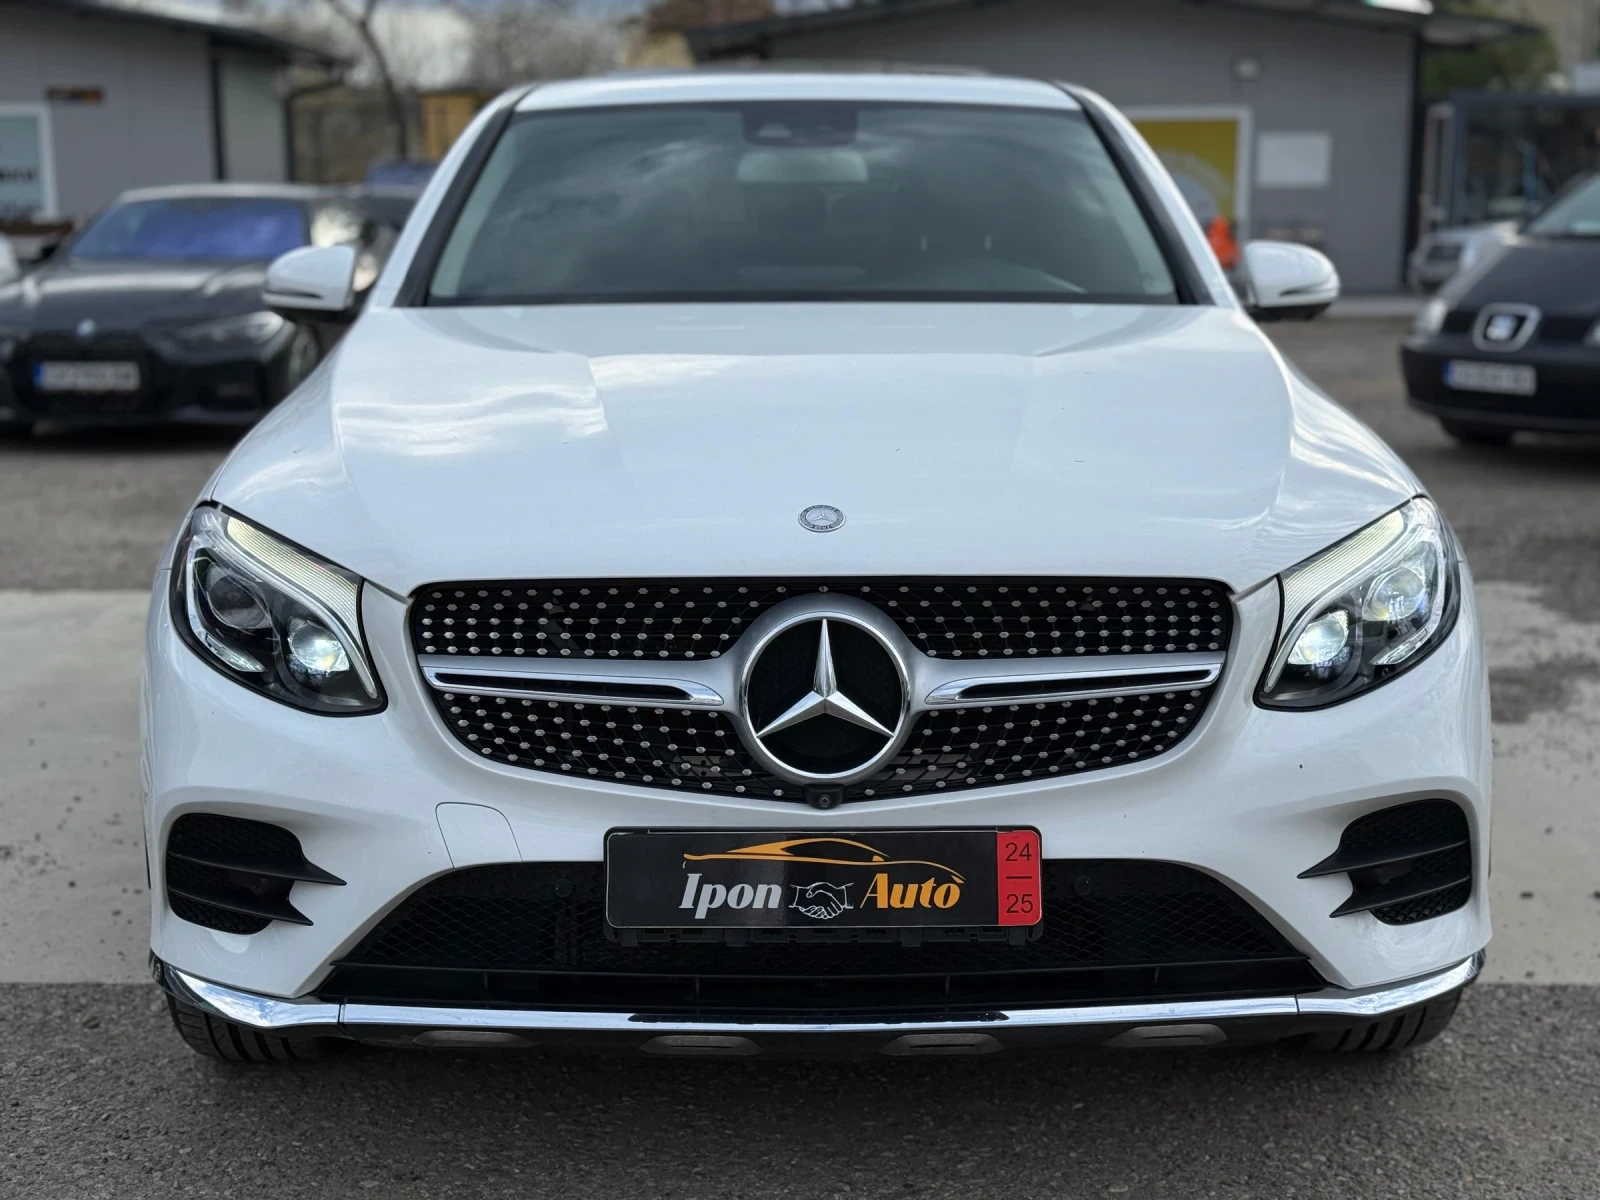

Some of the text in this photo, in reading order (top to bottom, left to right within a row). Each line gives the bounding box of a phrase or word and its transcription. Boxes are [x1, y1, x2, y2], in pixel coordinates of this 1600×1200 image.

[1005, 842, 1032, 862] 24
[678, 873, 961, 920] Ipon Auto
[1006, 893, 1034, 914] 25
